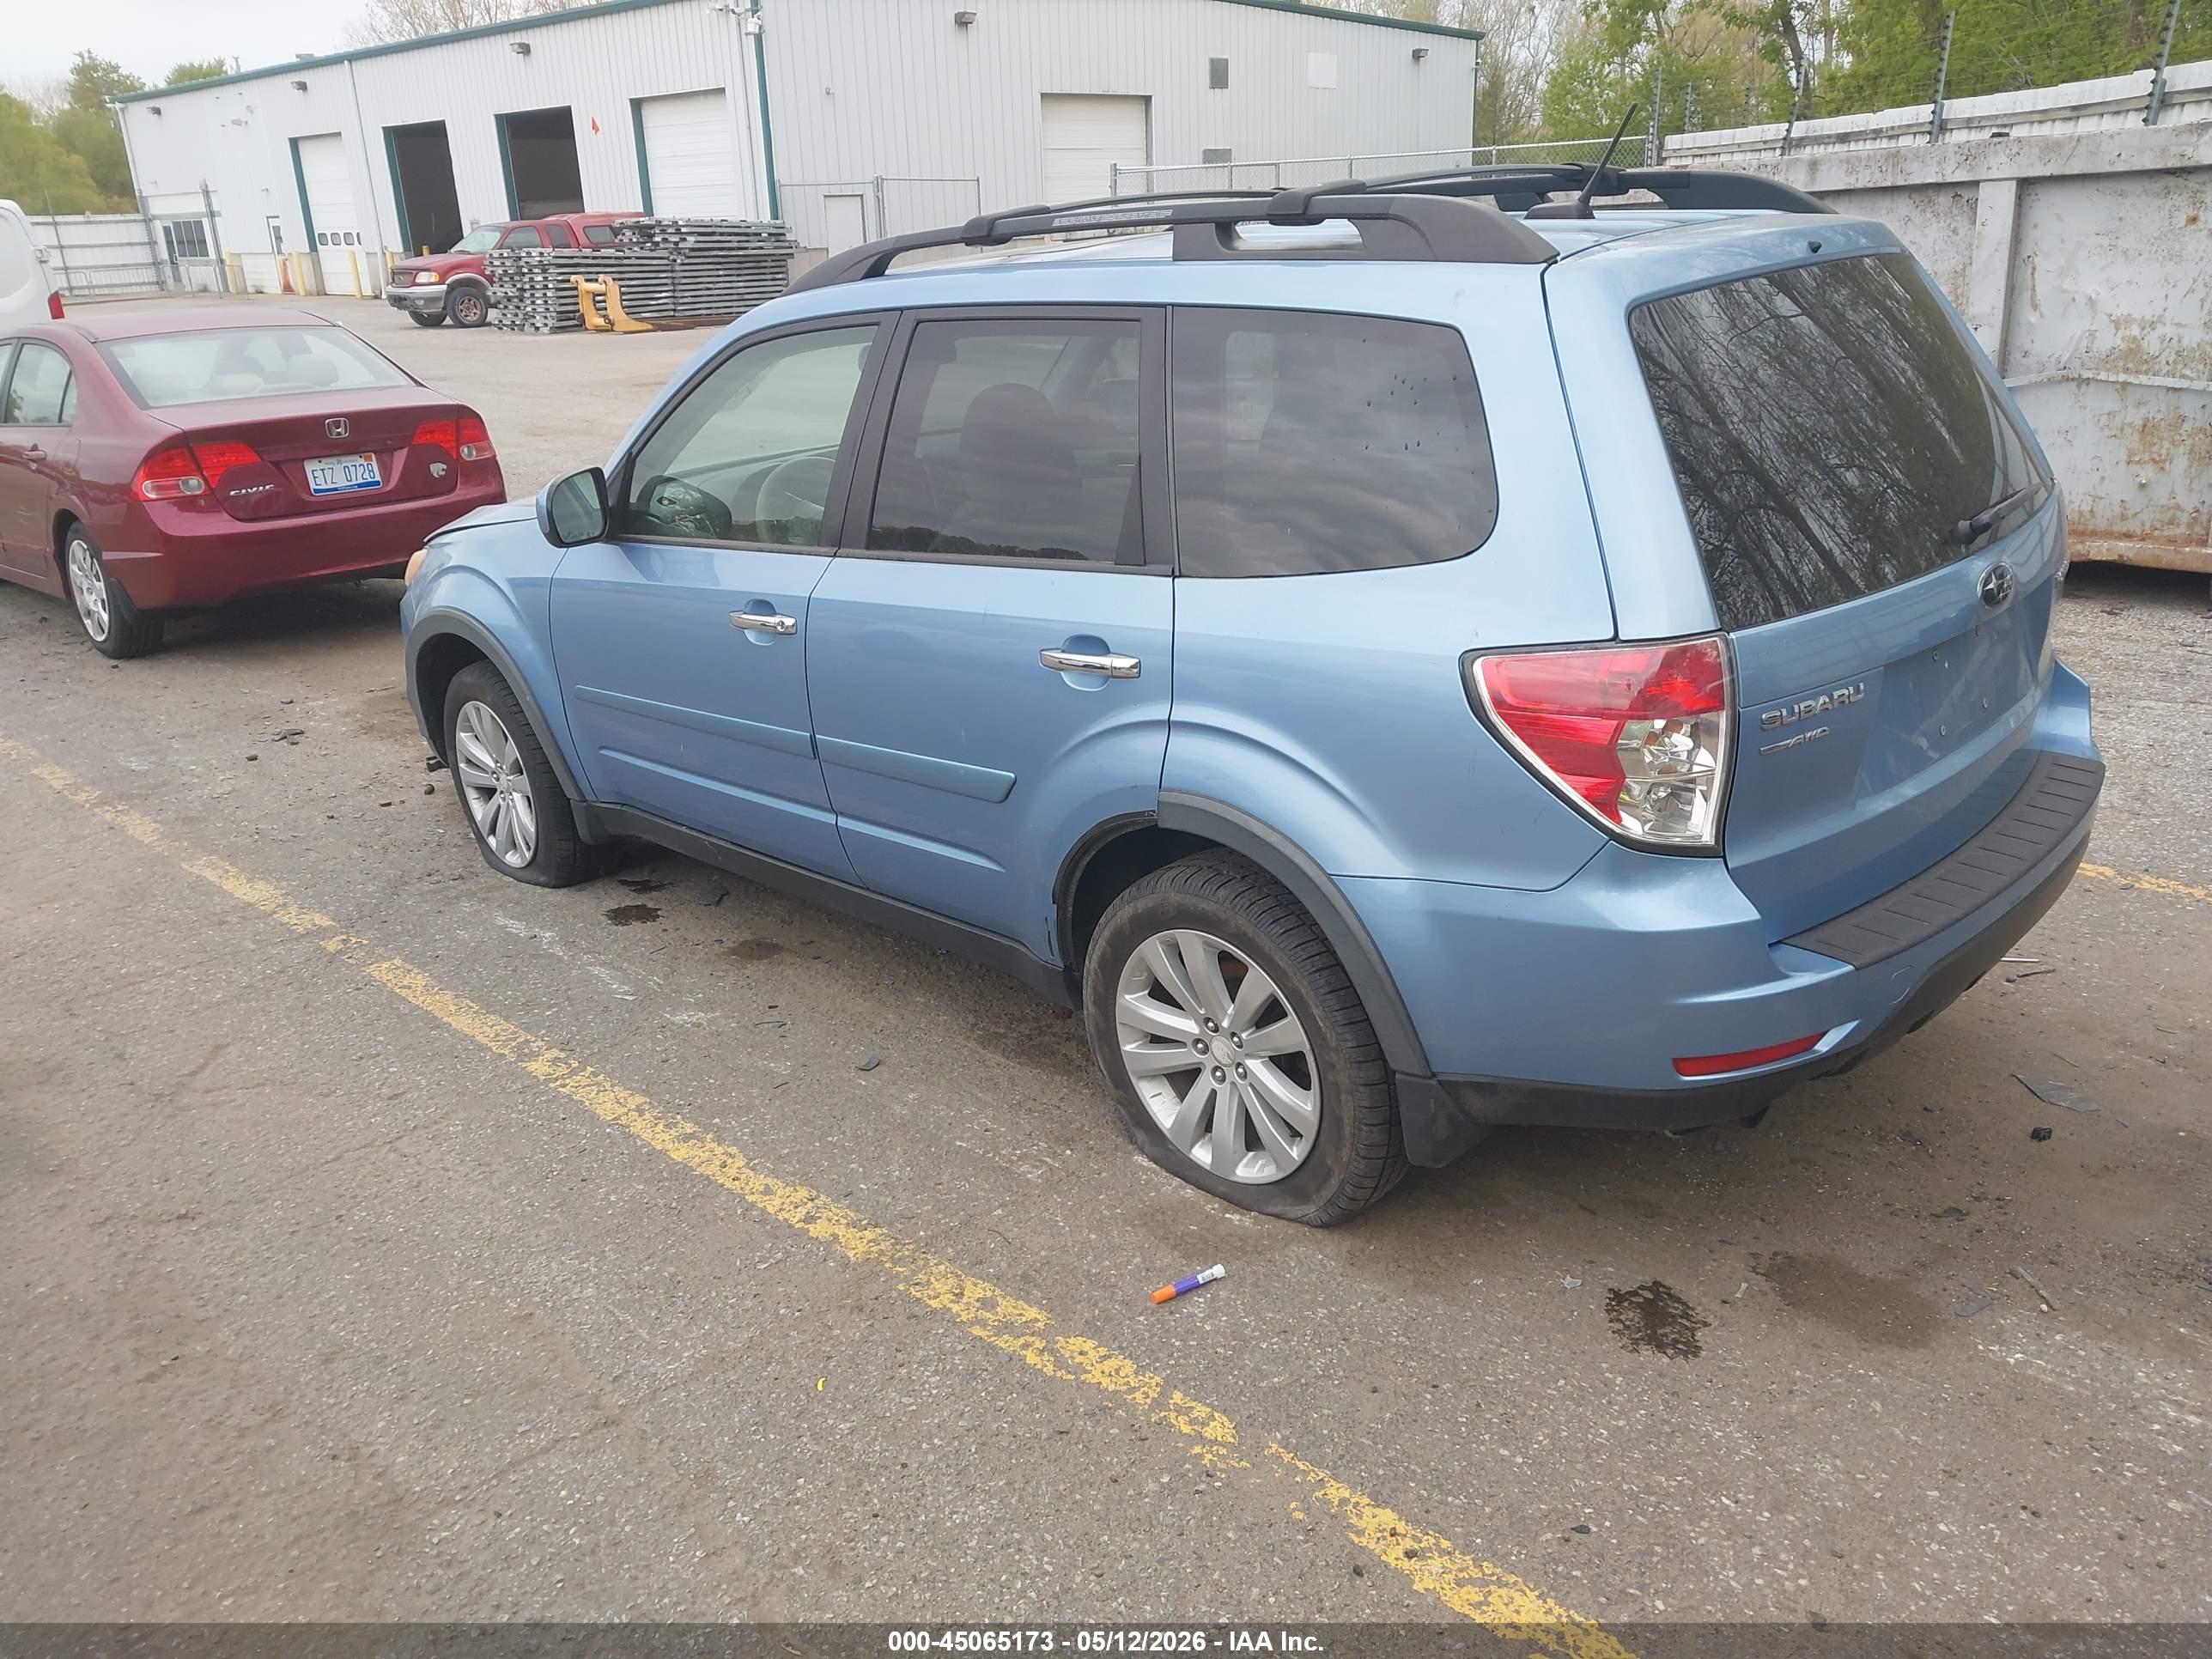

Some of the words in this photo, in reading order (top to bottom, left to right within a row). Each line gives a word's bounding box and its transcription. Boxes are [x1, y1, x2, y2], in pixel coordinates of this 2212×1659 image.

[311, 467, 337, 487] ETZ
[343, 463, 376, 483] 0728
[228, 483, 276, 496] CIVIC
[1760, 682, 1865, 731] SUBARU
[1787, 726, 1830, 748] AWD
